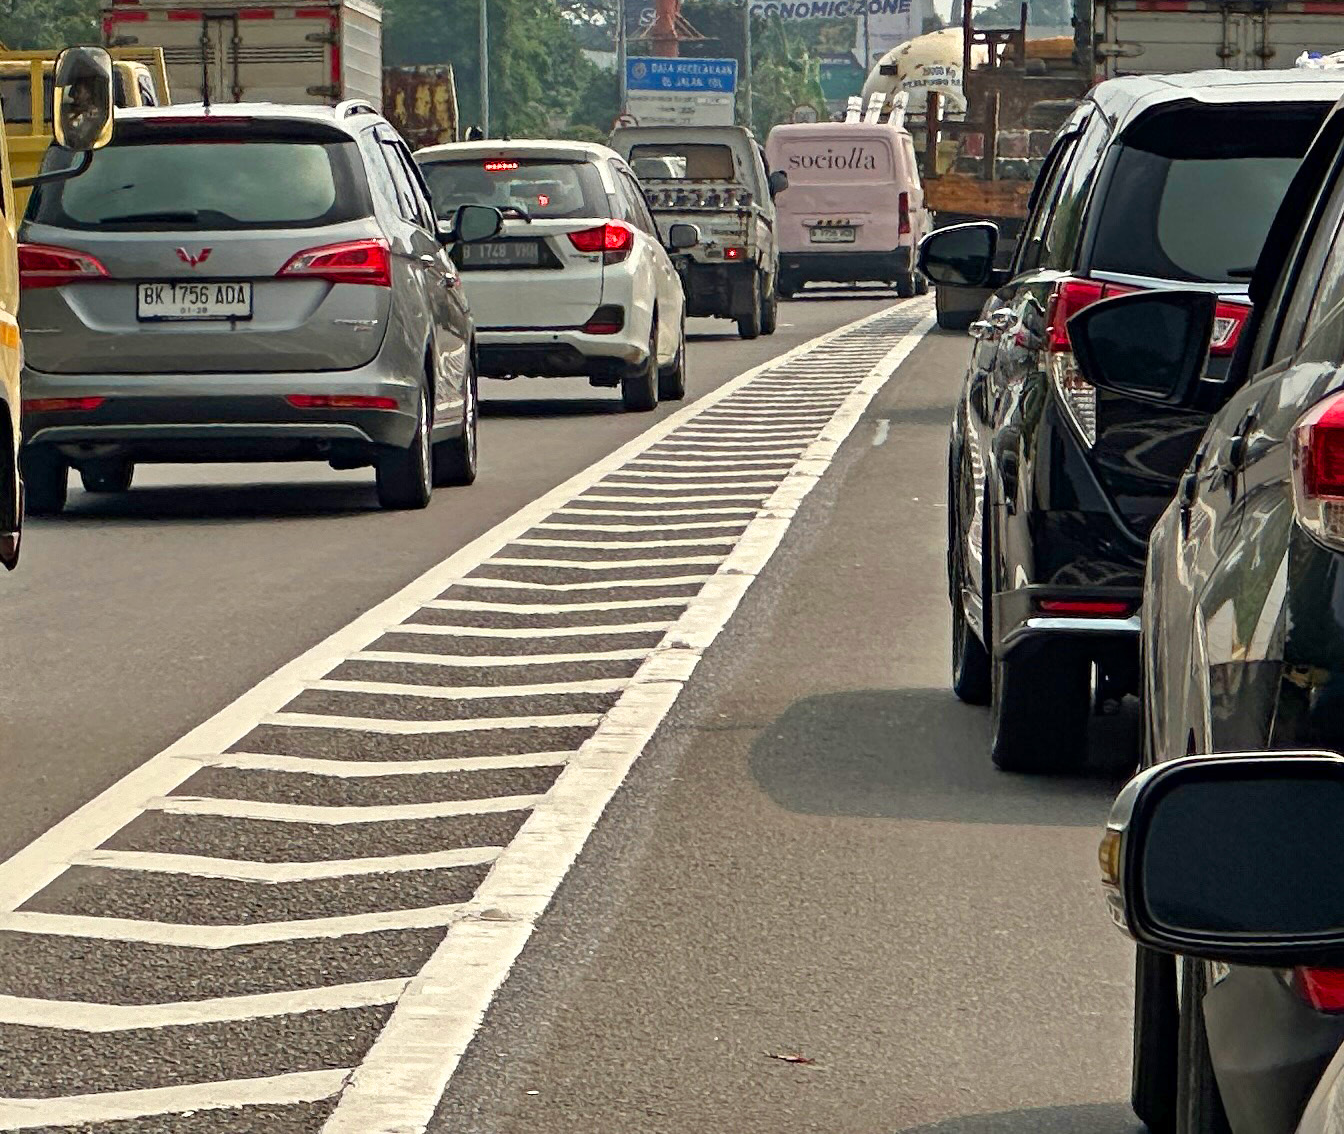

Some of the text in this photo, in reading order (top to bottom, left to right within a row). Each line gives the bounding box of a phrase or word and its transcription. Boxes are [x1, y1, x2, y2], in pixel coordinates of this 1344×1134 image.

[788, 147, 876, 170] sociolla
[144, 285, 246, 305] BK 1756 ADA
